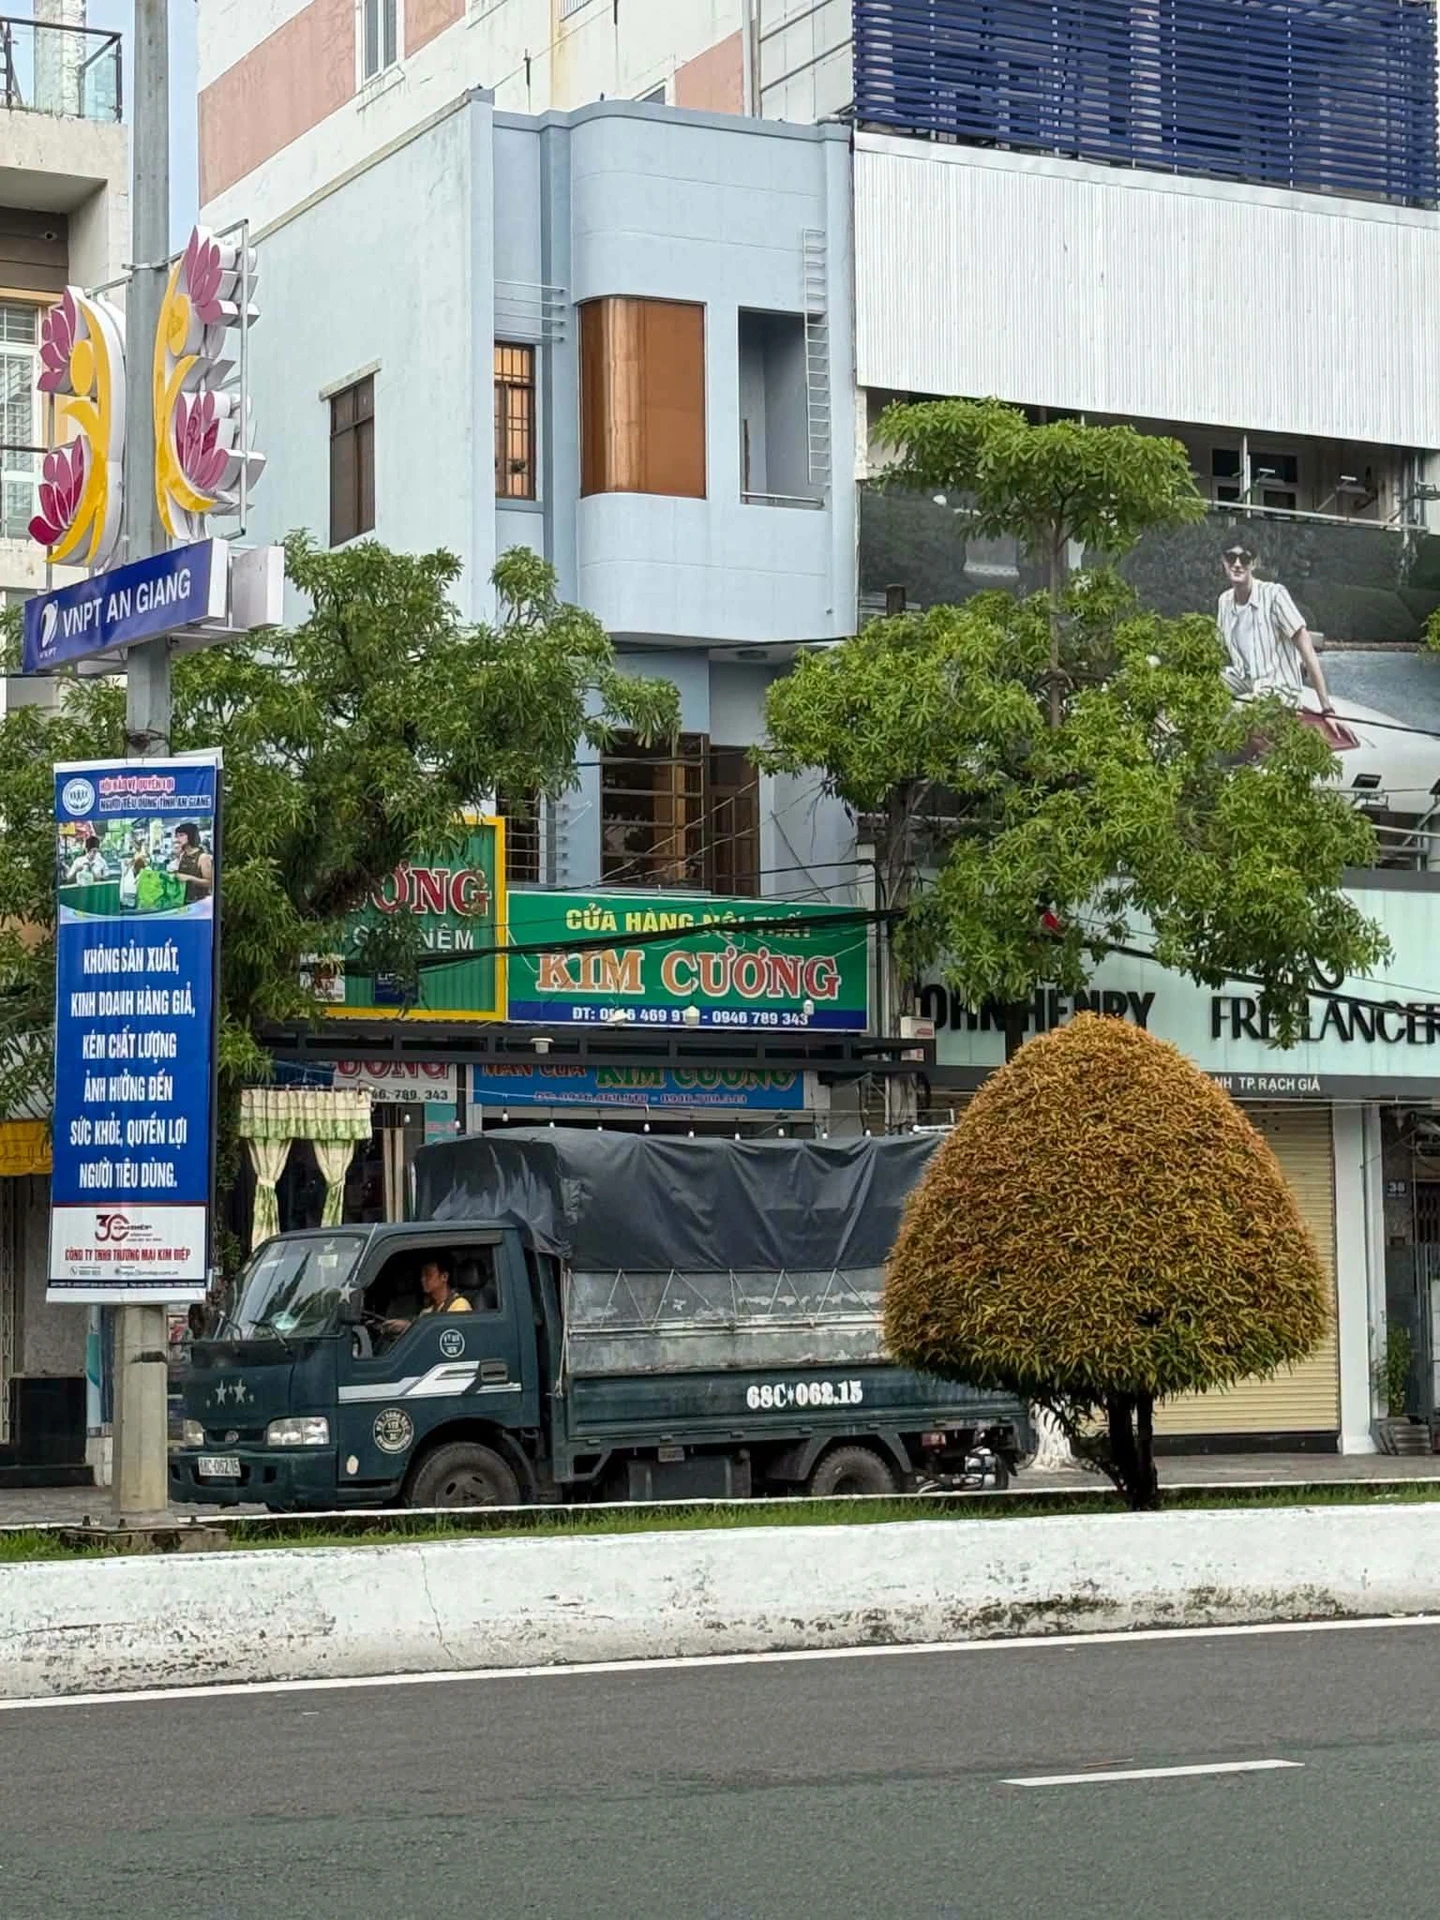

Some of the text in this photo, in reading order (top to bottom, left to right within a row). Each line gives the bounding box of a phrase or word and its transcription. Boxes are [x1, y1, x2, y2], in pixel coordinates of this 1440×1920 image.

[62, 568, 191, 638] VNPT AN GIANG
[346, 861, 492, 916] ƠNG
[566, 902, 617, 931] CỬA
[625, 907, 694, 932] HÀNG
[83, 937, 180, 975] KHÔNG SẢN XUẤT,
[536, 946, 841, 1000] KIM CƯƠNG
[71, 981, 196, 1018] KINH DOANH HÀNG GIẢ,
[640, 1008, 667, 1022] 469
[671, 1009, 690, 1023] 91
[712, 1010, 747, 1024] 0946
[751, 1011, 778, 1025] 789
[782, 1012, 809, 1026] 343
[82, 1024, 177, 1064] KÉM CHẤT LƯỢNG
[83, 1067, 173, 1103] ẢNH HƯỞNG ĐẾN
[1298, 1075, 1321, 1091] GIÁ
[70, 1115, 92, 1146] SỨC
[94, 1111, 123, 1147] KHỎE,
[168, 1116, 188, 1150] LỢI
[79, 1156, 178, 1189] NGƯỜI TIÊU DÙNG.
[64, 1246, 83, 1261] CÔNG
[84, 1249, 93, 1261] TY
[141, 1248, 156, 1264] MẠI
[158, 1248, 172, 1261] KIM
